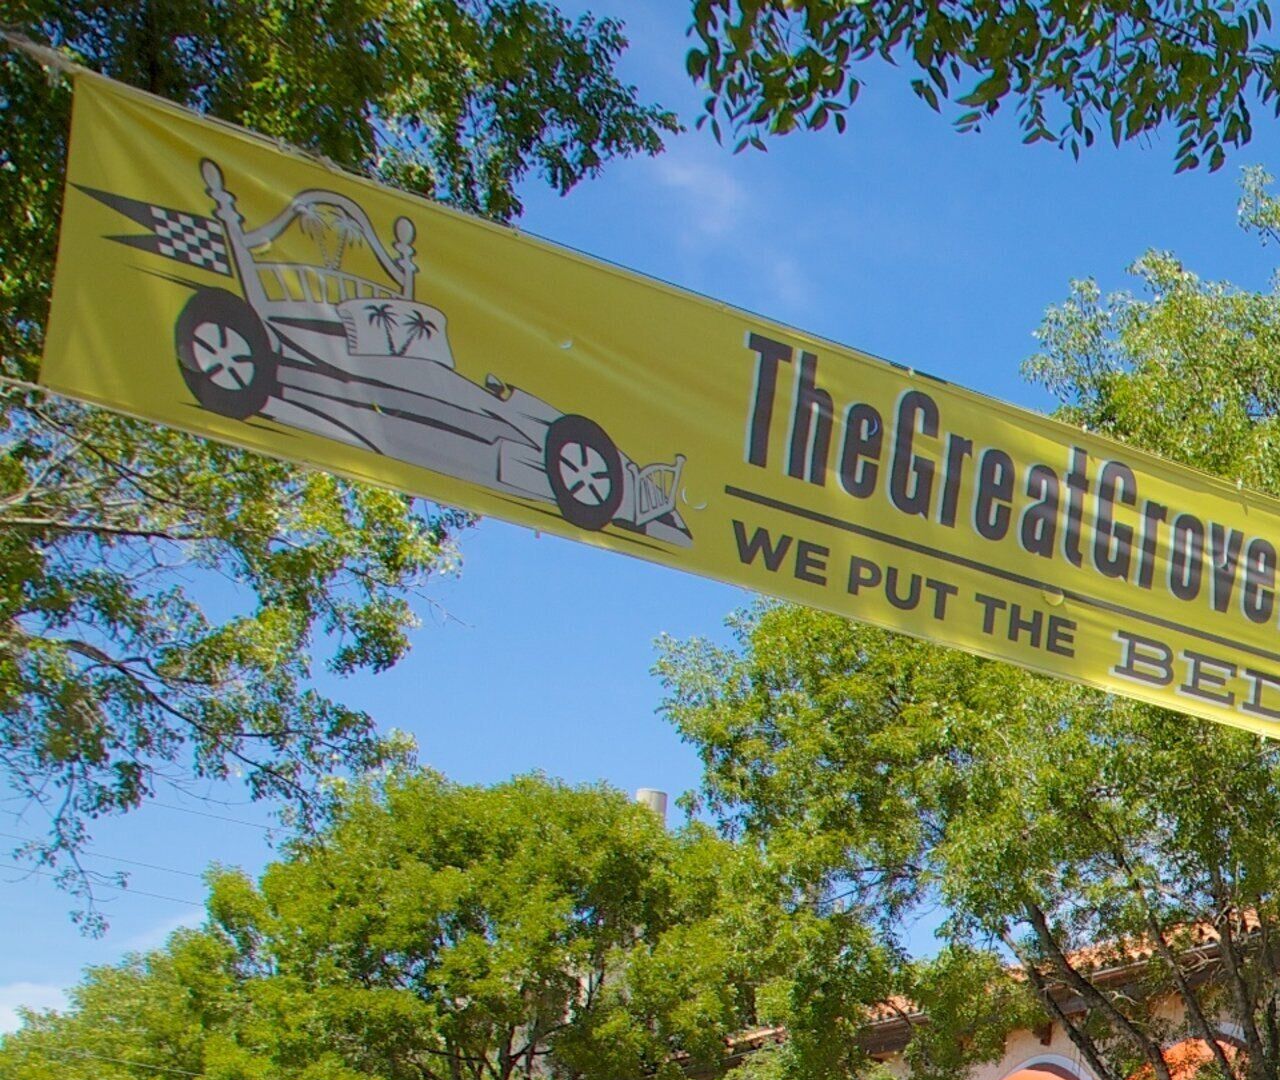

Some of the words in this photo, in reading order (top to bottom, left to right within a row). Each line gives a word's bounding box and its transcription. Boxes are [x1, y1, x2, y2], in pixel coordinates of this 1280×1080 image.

[731, 518, 831, 586] WE
[847, 555, 959, 621] PUT
[975, 592, 1078, 658] THE
